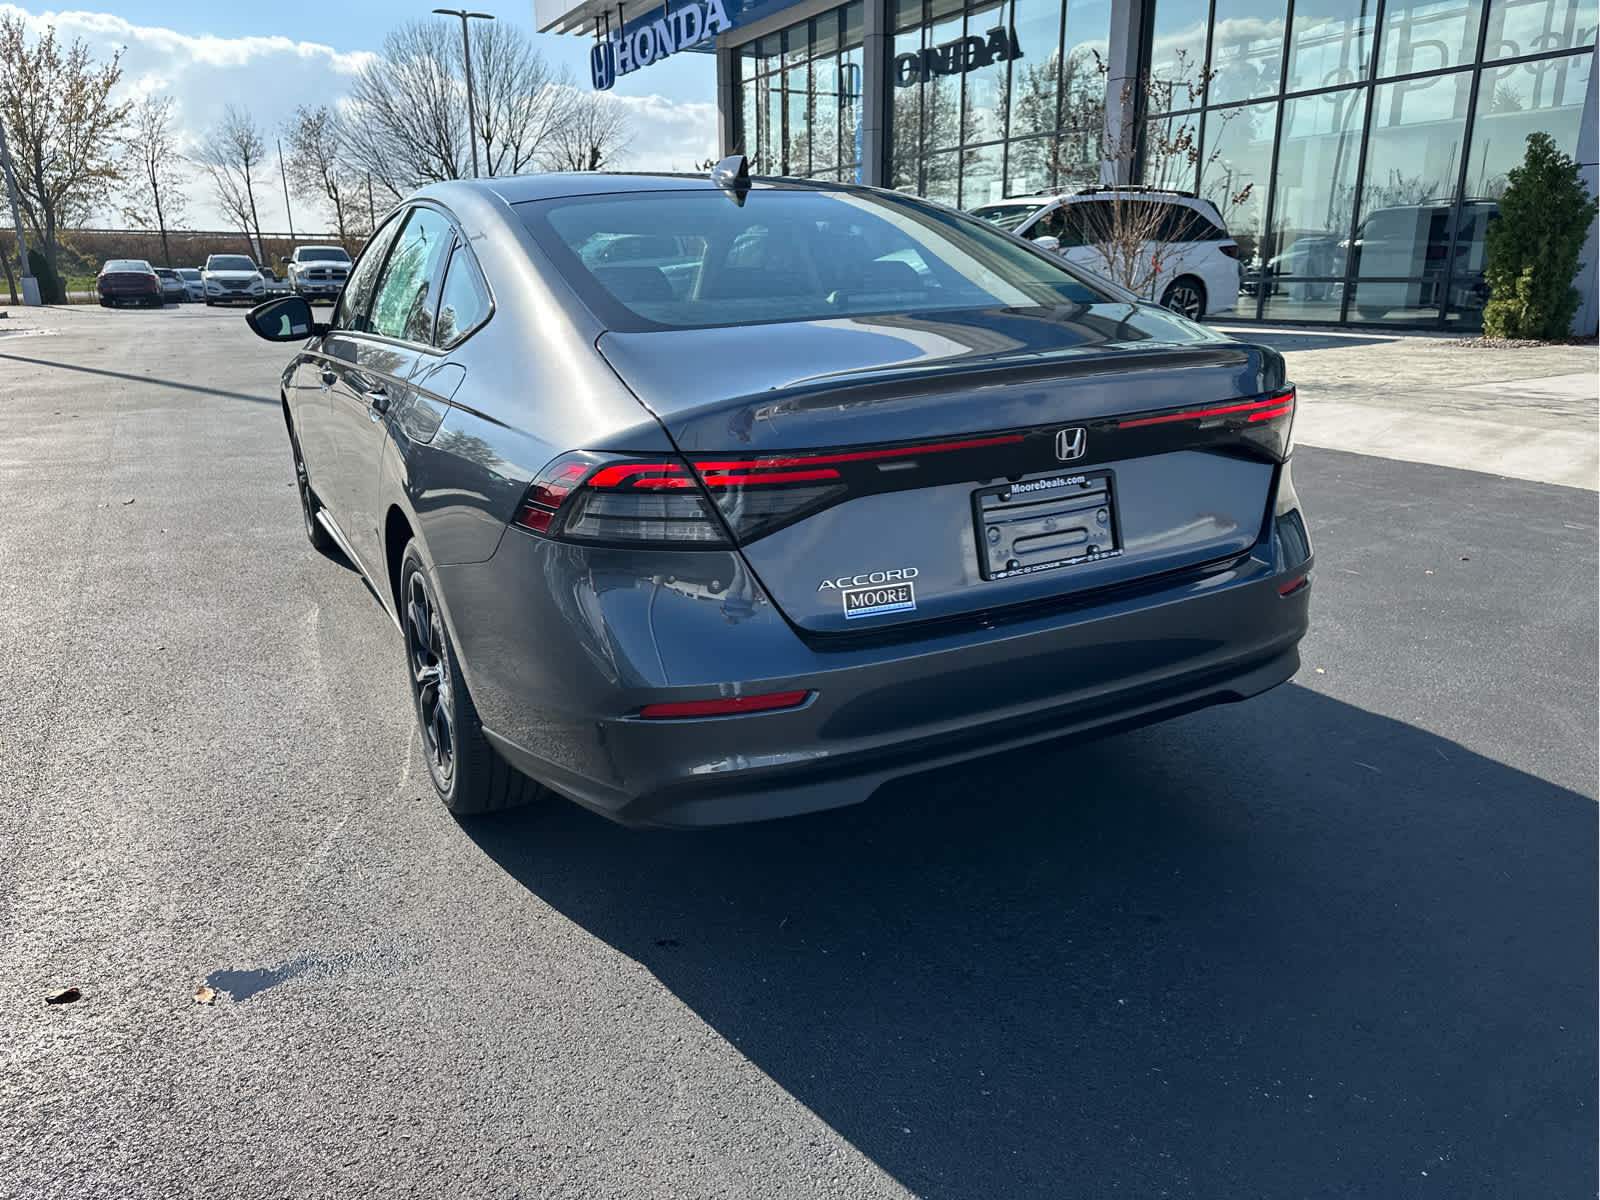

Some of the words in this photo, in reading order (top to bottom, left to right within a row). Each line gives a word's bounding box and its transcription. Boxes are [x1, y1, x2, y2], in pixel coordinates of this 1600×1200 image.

[613, 0, 732, 76] HONDA
[894, 25, 1025, 88] ONDA
[1011, 475, 1086, 494] MooreDeals.com
[817, 567, 919, 592] ACCORD
[850, 587, 908, 608] MOORE
